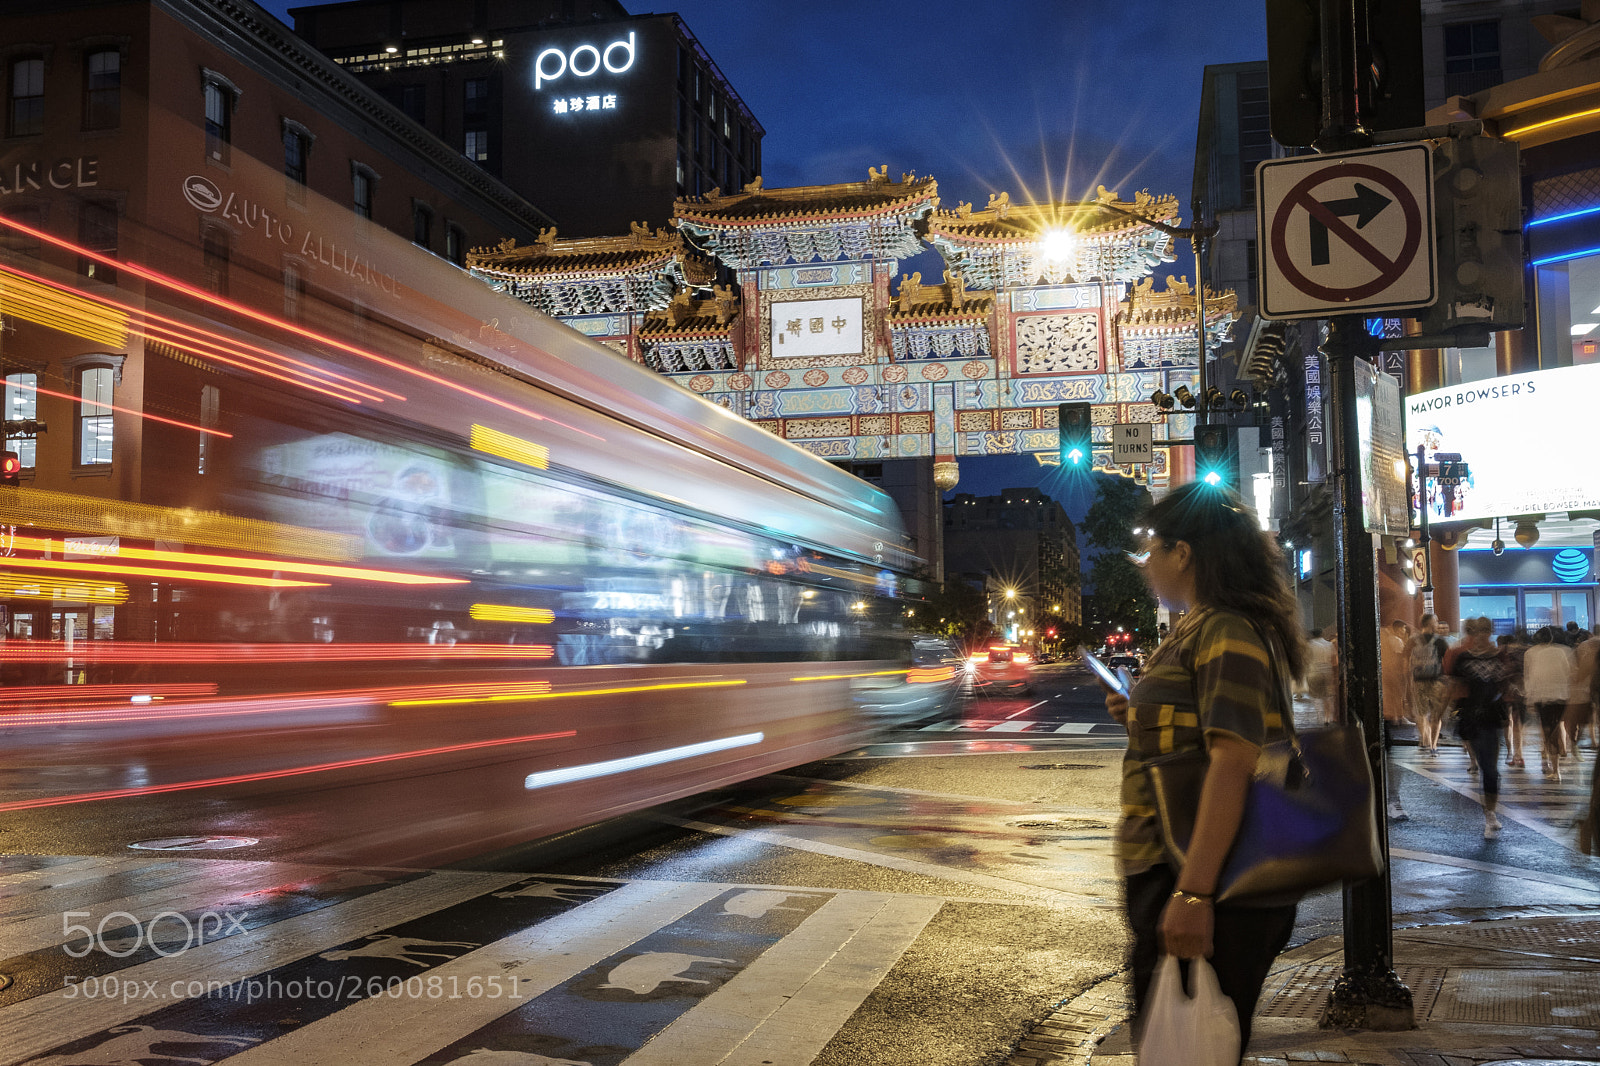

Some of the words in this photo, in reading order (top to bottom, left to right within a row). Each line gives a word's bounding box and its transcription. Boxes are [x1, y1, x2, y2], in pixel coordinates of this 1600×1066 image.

[535, 31, 635, 90] pod
[553, 94, 617, 114] 袖珍酒店
[222, 192, 292, 245] AUTO
[301, 230, 402, 300] ALLIANCE
[1304, 355, 1323, 445] 美國娛樂公司
[1411, 395, 1452, 415] MAYOR
[1456, 381, 1536, 406] BOWSER'S
[1125, 428, 1139, 438] NO
[1118, 443, 1148, 454] TURNS
[1443, 464, 1452, 476] 7
[1439, 477, 1459, 485] 700
